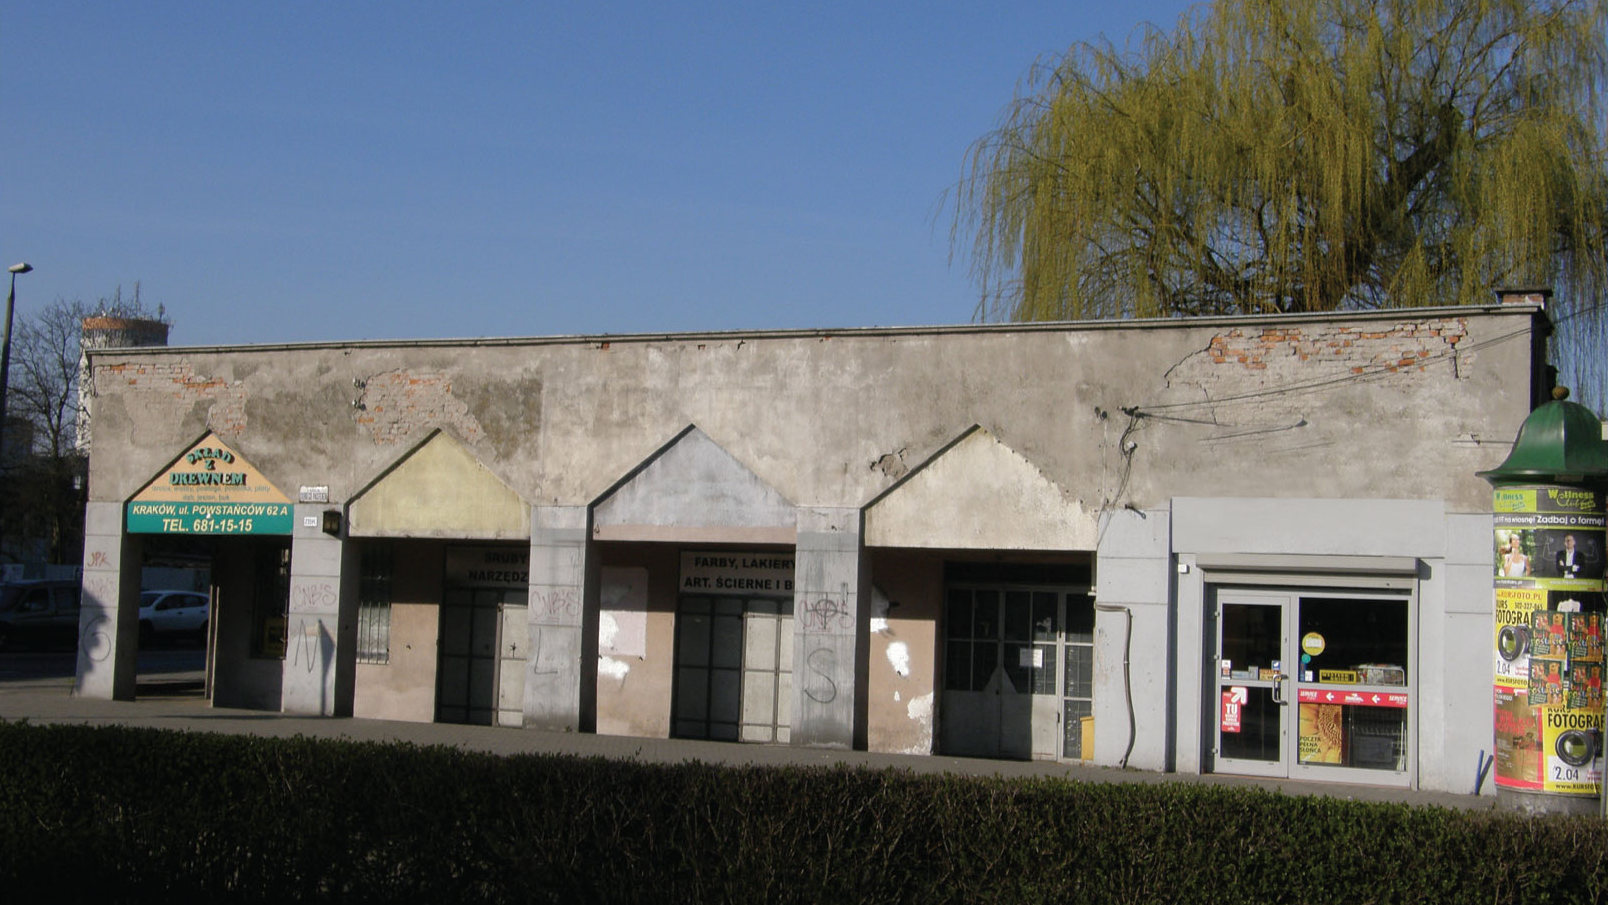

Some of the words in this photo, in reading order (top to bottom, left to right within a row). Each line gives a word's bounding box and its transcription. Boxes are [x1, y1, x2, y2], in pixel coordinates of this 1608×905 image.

[169, 472, 247, 486] DREWNEM
[133, 504, 176, 516] KRAKÓW,
[179, 506, 189, 514] ul.
[192, 504, 265, 516] POWSTAŃCÓW
[267, 506, 278, 515] 62
[280, 506, 288, 515] A
[163, 519, 189, 531] TEL.
[193, 519, 253, 532] 681-15-15
[1537, 515, 1568, 525] Zadbaj
[694, 557, 738, 569] FARBY,
[684, 576, 711, 588] ART.
[716, 576, 772, 590] ŚCIERNE
[1226, 703, 1238, 714] TU
[1555, 766, 1579, 781] 2.04
